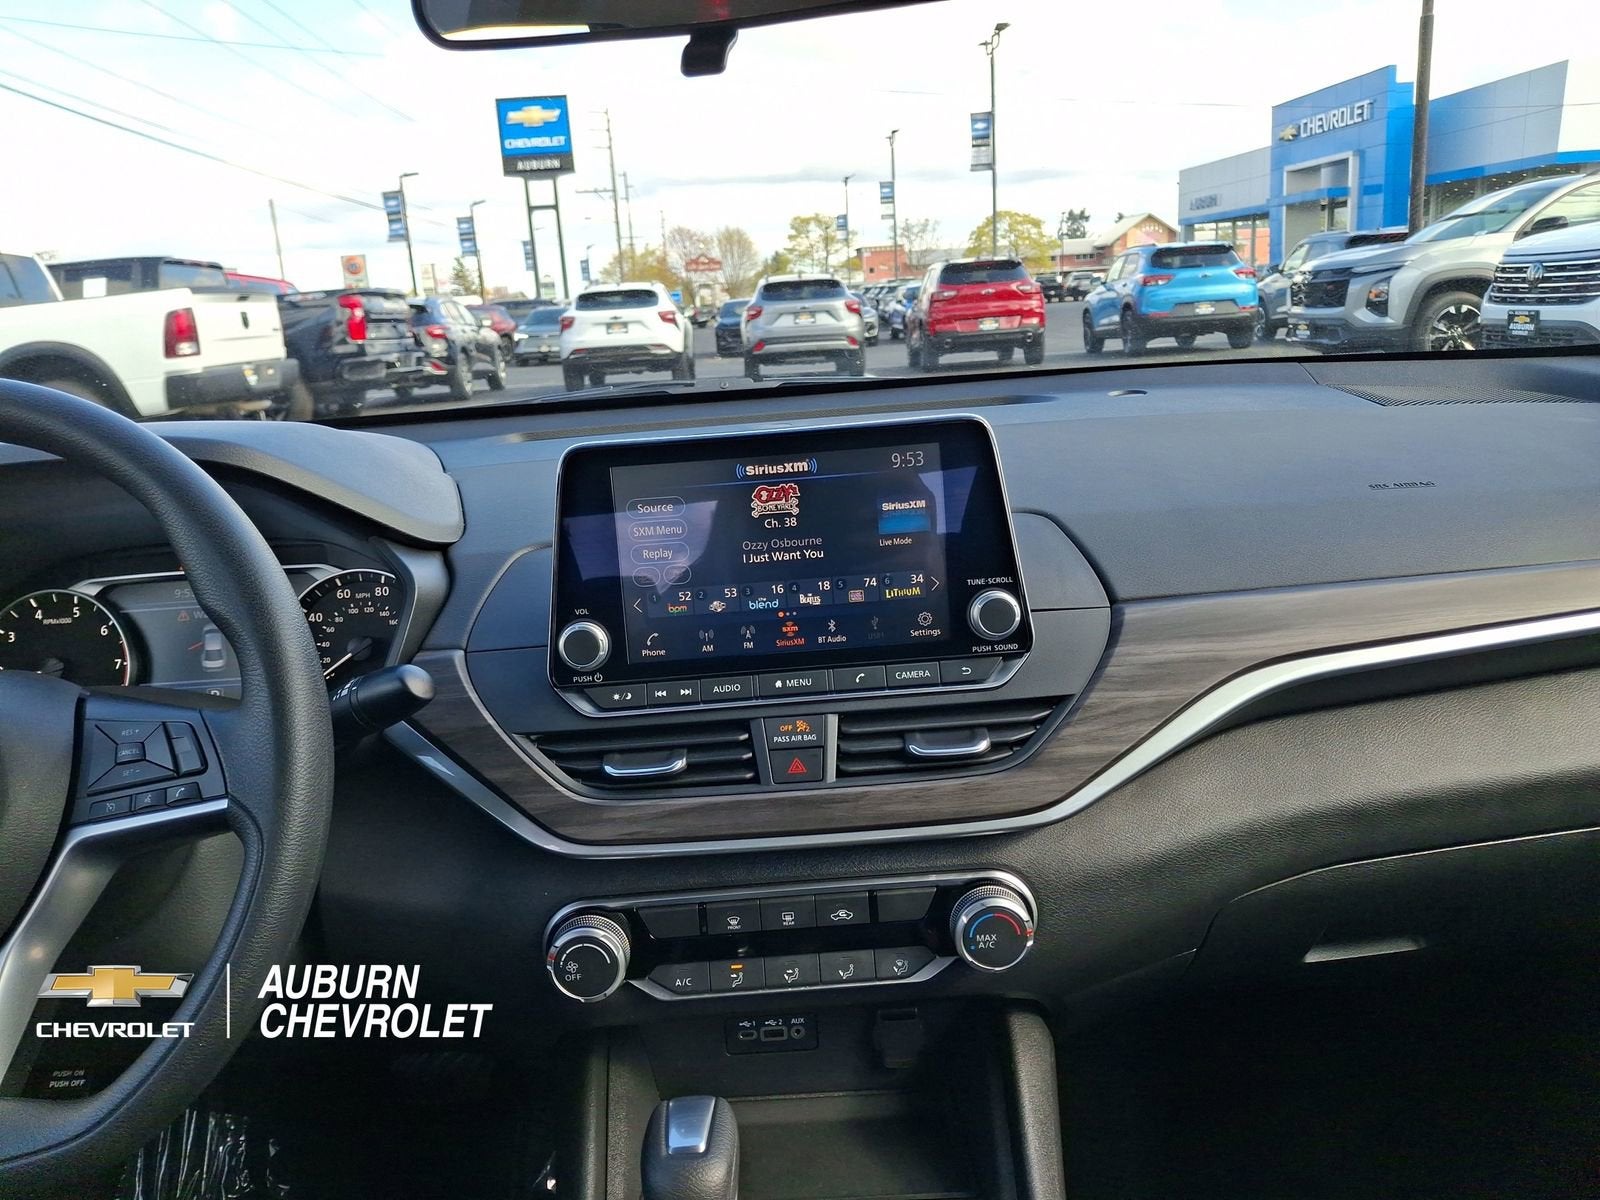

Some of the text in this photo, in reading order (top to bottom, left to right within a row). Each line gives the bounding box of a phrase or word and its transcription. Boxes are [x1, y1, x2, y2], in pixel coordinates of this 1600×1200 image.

[1300, 100, 1373, 138] CHEVROLET
[517, 158, 561, 171] AUBURN
[891, 450, 924, 468] 9:53
[637, 502, 674, 514] Source
[881, 499, 926, 511] SiriusXM
[764, 517, 797, 529] Ch. 38
[633, 524, 682, 537] SXM Menu
[742, 537, 823, 552] Ozzy Osbourne
[879, 536, 913, 547] Live Mode
[642, 549, 673, 561] Replay
[742, 549, 824, 564] I Just Want You
[863, 577, 877, 588] 74
[884, 577, 890, 585] 6
[910, 574, 925, 584] 34
[771, 584, 784, 595] 16
[817, 580, 831, 591] 18
[336, 589, 351, 599] 60
[375, 586, 390, 597] 80
[678, 591, 691, 602] 52
[724, 588, 737, 598] 53
[668, 603, 688, 615] bpm
[748, 598, 779, 610] blend
[35, 609, 43, 620] 4
[72, 606, 80, 618] 5
[308, 612, 323, 623] 40
[100, 625, 109, 636] 6
[910, 628, 942, 638] Settings
[7, 632, 16, 643] 3
[776, 637, 805, 647] SiriusXM
[827, 635, 847, 643] Audio
[972, 643, 1019, 653] PUSH SOUND
[114, 659, 122, 670] 7
[322, 656, 331, 664] 20
[573, 675, 593, 683] PUSH
[895, 671, 931, 680] CAMERA
[713, 683, 741, 693] AUDIO
[786, 678, 812, 688] MENU
[803, 733, 817, 741] BAG
[976, 934, 997, 942] MAX
[978, 940, 995, 949] A/C
[565, 973, 582, 982] OFF
[675, 978, 692, 987] A/C
[49, 1079, 86, 1088] PUSH OFF
